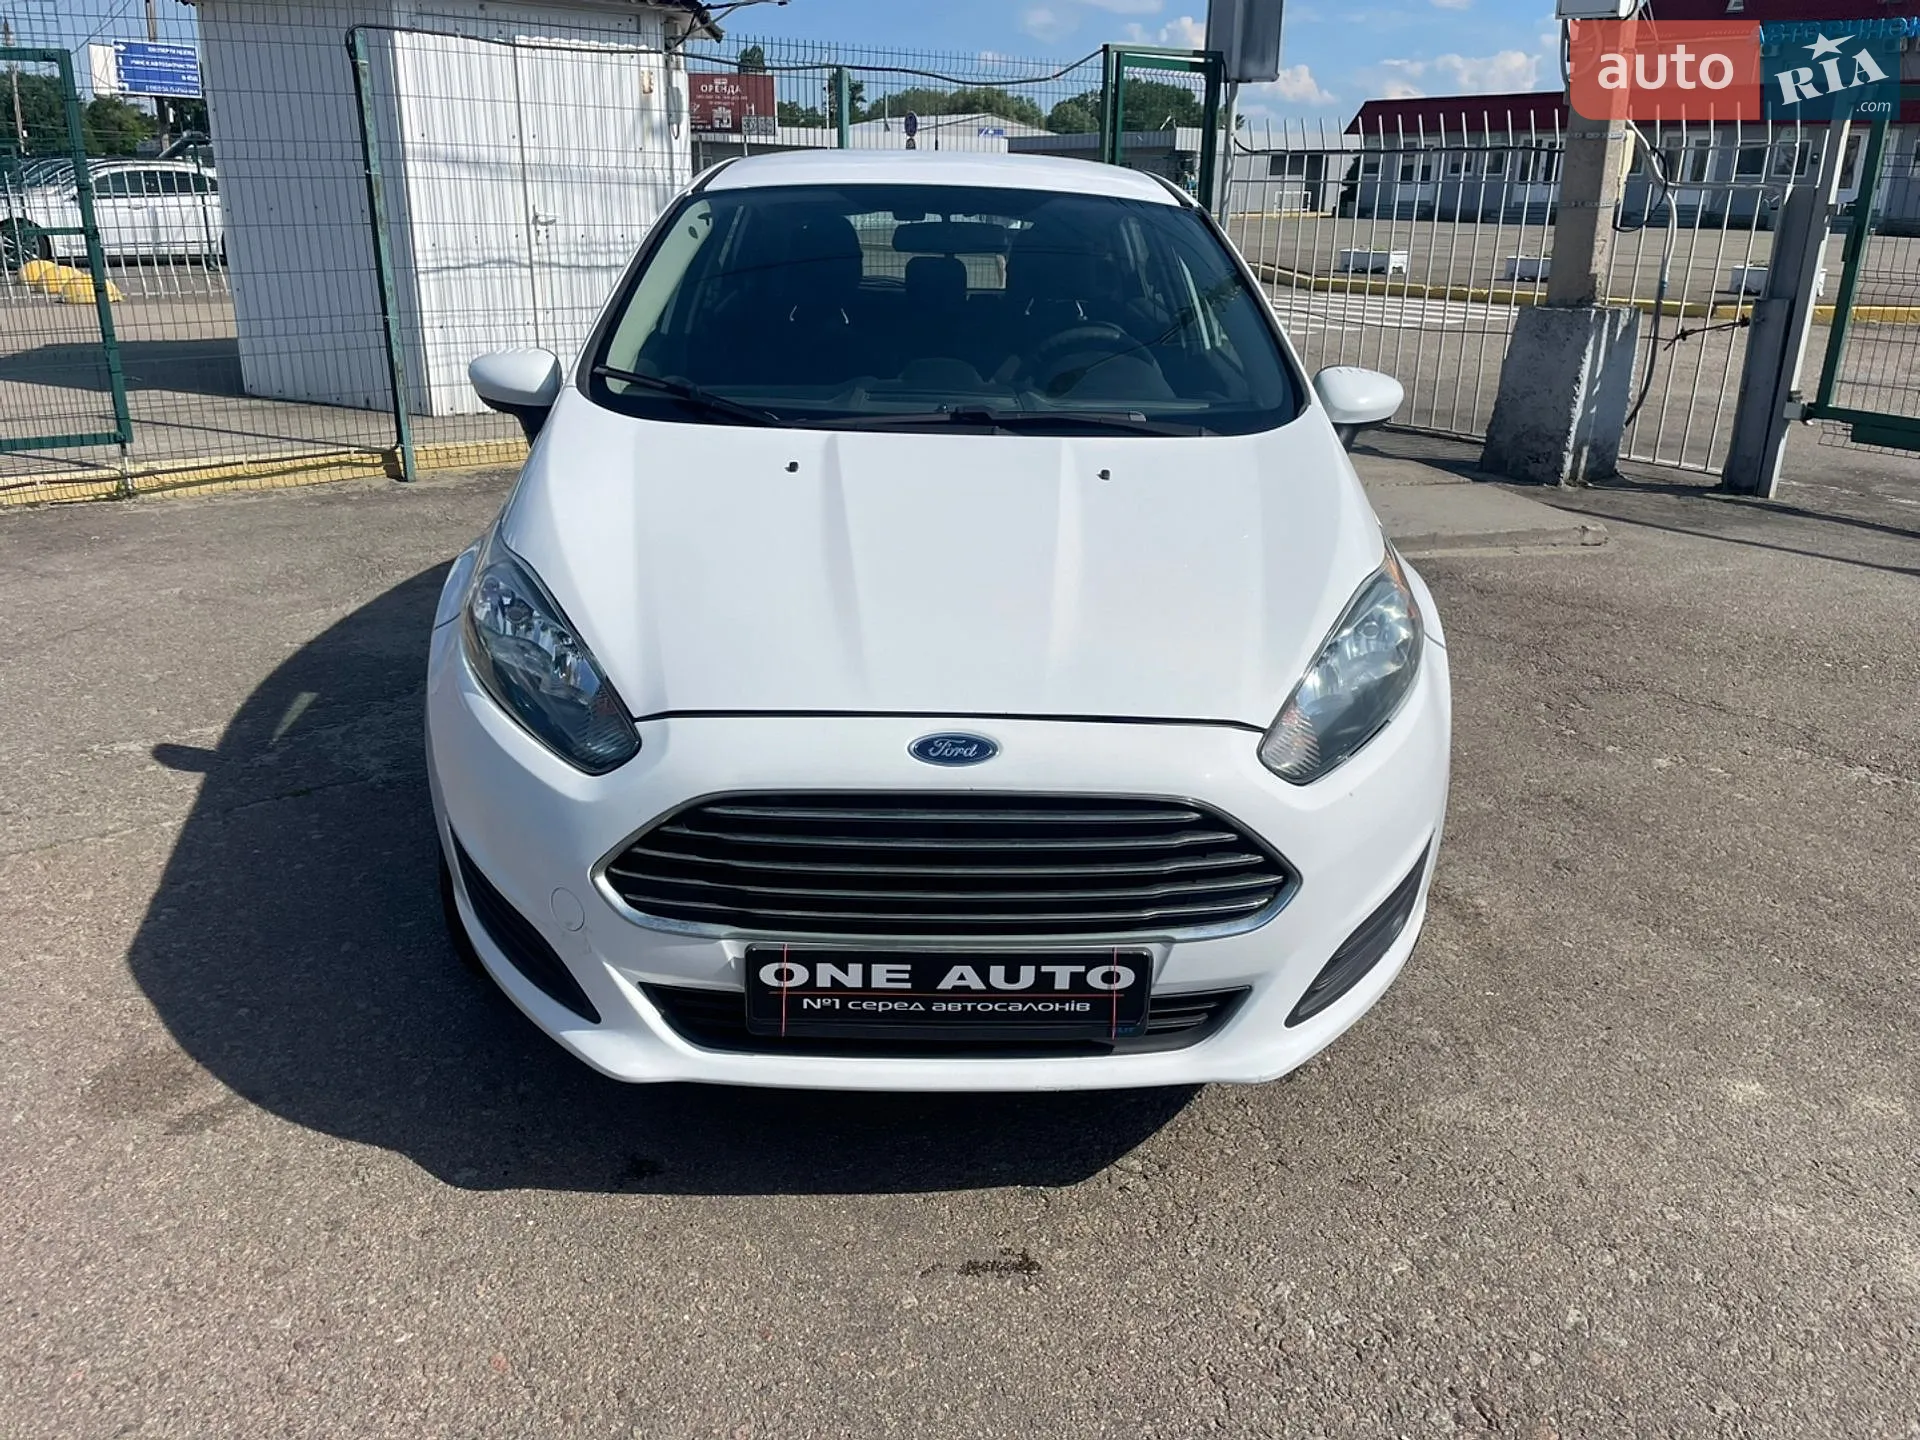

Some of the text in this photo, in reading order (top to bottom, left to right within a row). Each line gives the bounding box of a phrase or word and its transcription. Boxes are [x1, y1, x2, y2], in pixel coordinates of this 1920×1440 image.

[700, 84, 741, 95] ОРЕНДА
[928, 739, 978, 757] Ford
[758, 962, 1136, 990] ONE AUTO
[848, 1001, 925, 1013] серед
[931, 1000, 1091, 1012] автосалонів
